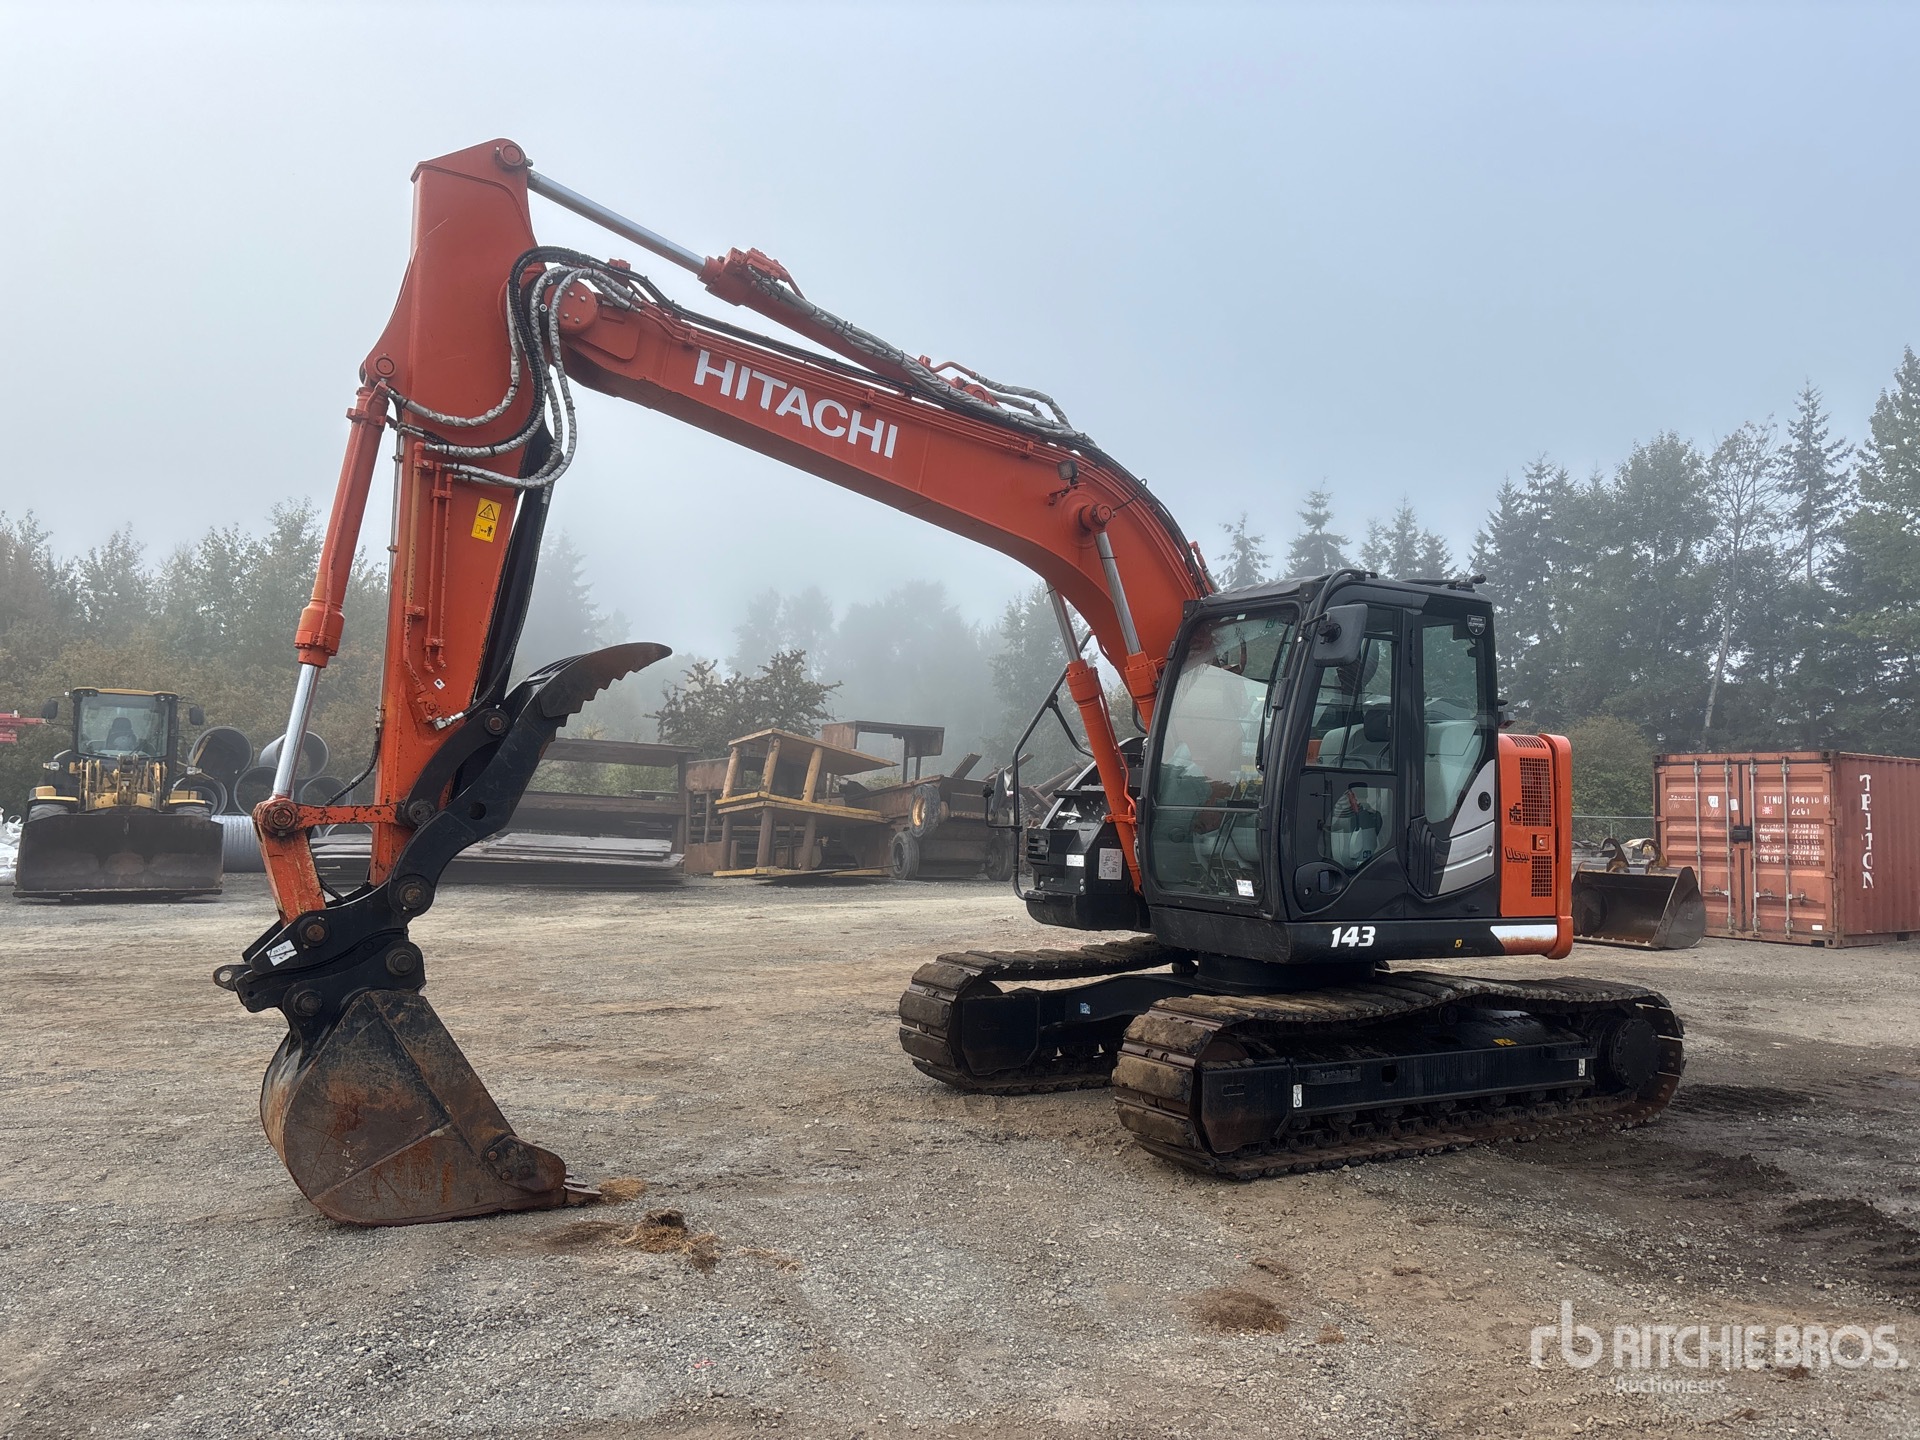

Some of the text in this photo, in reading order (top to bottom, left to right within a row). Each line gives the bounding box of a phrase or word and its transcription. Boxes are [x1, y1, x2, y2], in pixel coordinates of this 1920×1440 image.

[693, 349, 899, 459] HITACHI
[1859, 774, 1875, 889] TRITON
[1330, 926, 1376, 948] 143
